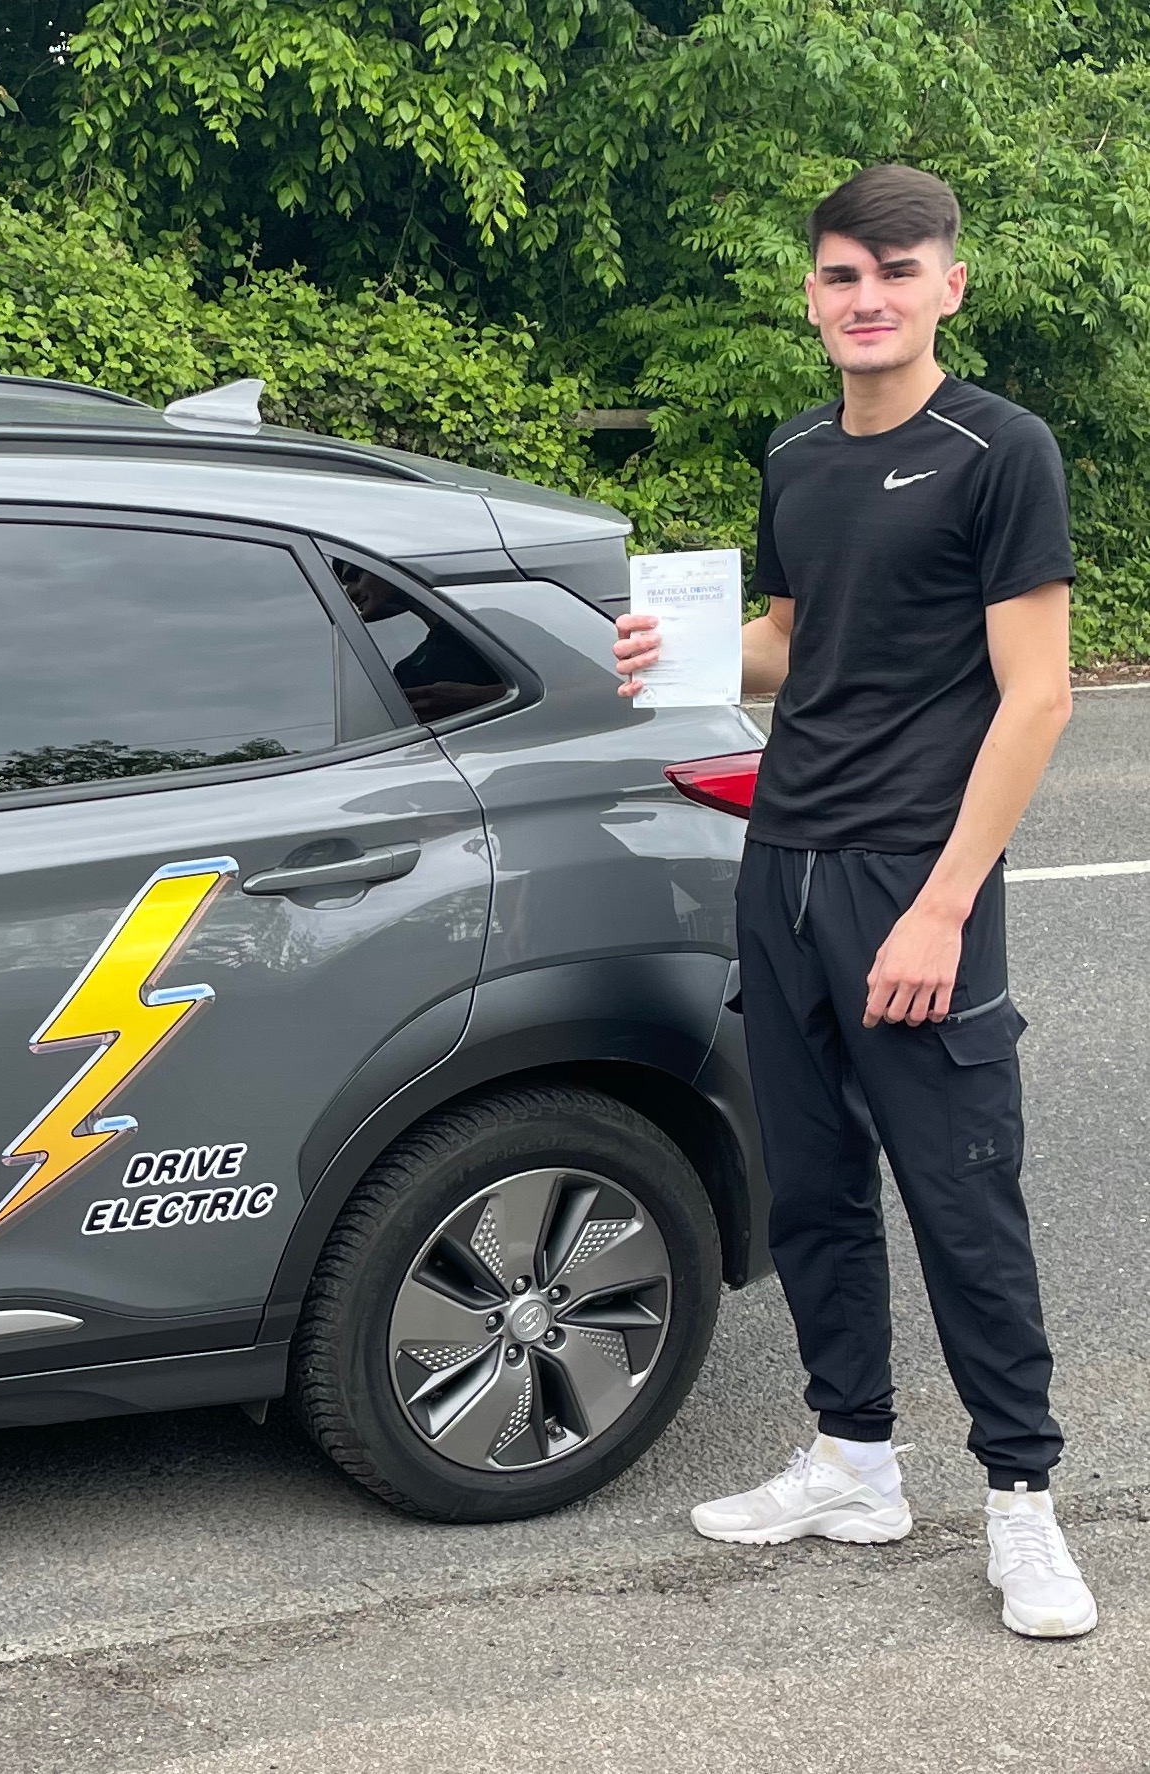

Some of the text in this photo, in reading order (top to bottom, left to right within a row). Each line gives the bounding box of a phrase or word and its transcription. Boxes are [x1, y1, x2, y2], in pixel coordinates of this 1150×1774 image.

[647, 585, 723, 596] PRACTICAL DRIVING
[122, 1143, 247, 1188] DRIVE
[81, 1182, 278, 1235] ELECTRIC
